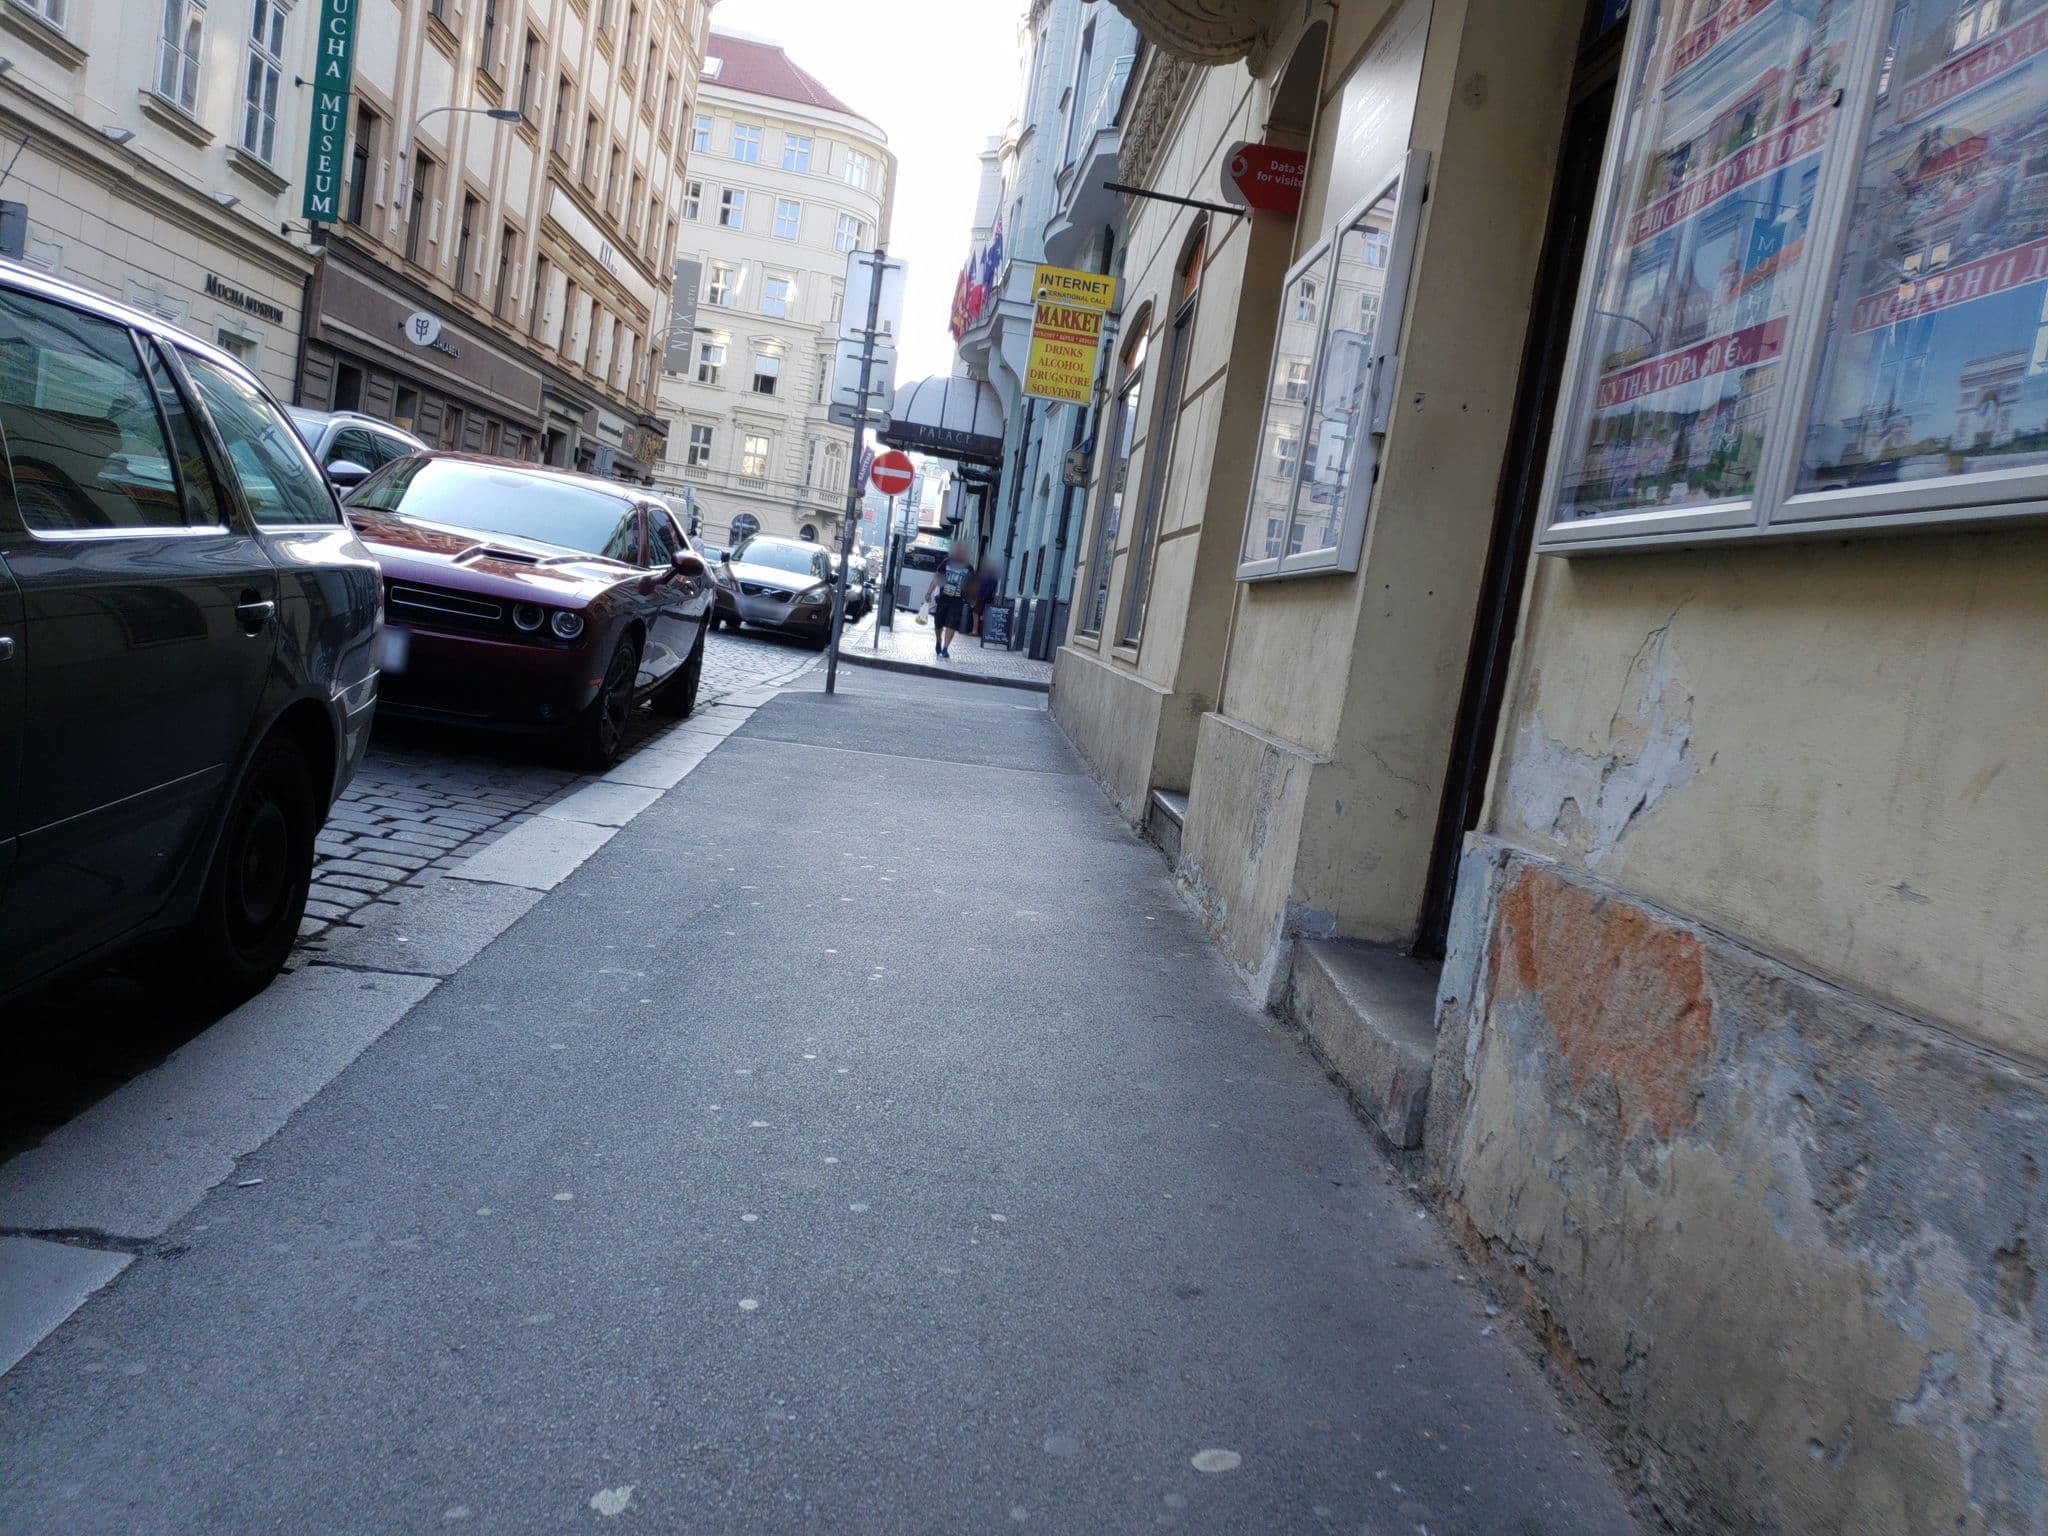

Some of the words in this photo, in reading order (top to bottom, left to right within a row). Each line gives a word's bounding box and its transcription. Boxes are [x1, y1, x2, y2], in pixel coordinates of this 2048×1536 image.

[310, 93, 342, 214] MUSEUM
[1270, 160, 1295, 174] Data
[1256, 171, 1273, 182] for
[1040, 273, 1109, 295] INTERNET
[1047, 289, 1088, 302] ERNATIONAL
[1036, 304, 1103, 334] MARKET
[671, 312, 693, 351] NYX
[1045, 343, 1084, 359] DRINKS
[1038, 357, 1086, 373] ALCOHOL
[1029, 368, 1090, 387] DRUGSTORE
[1598, 369, 1652, 407] КУТНА
[1655, 354, 1699, 391] ГОРА
[1031, 383, 1082, 400] SOUVENIR
[919, 426, 974, 444] PALACE
